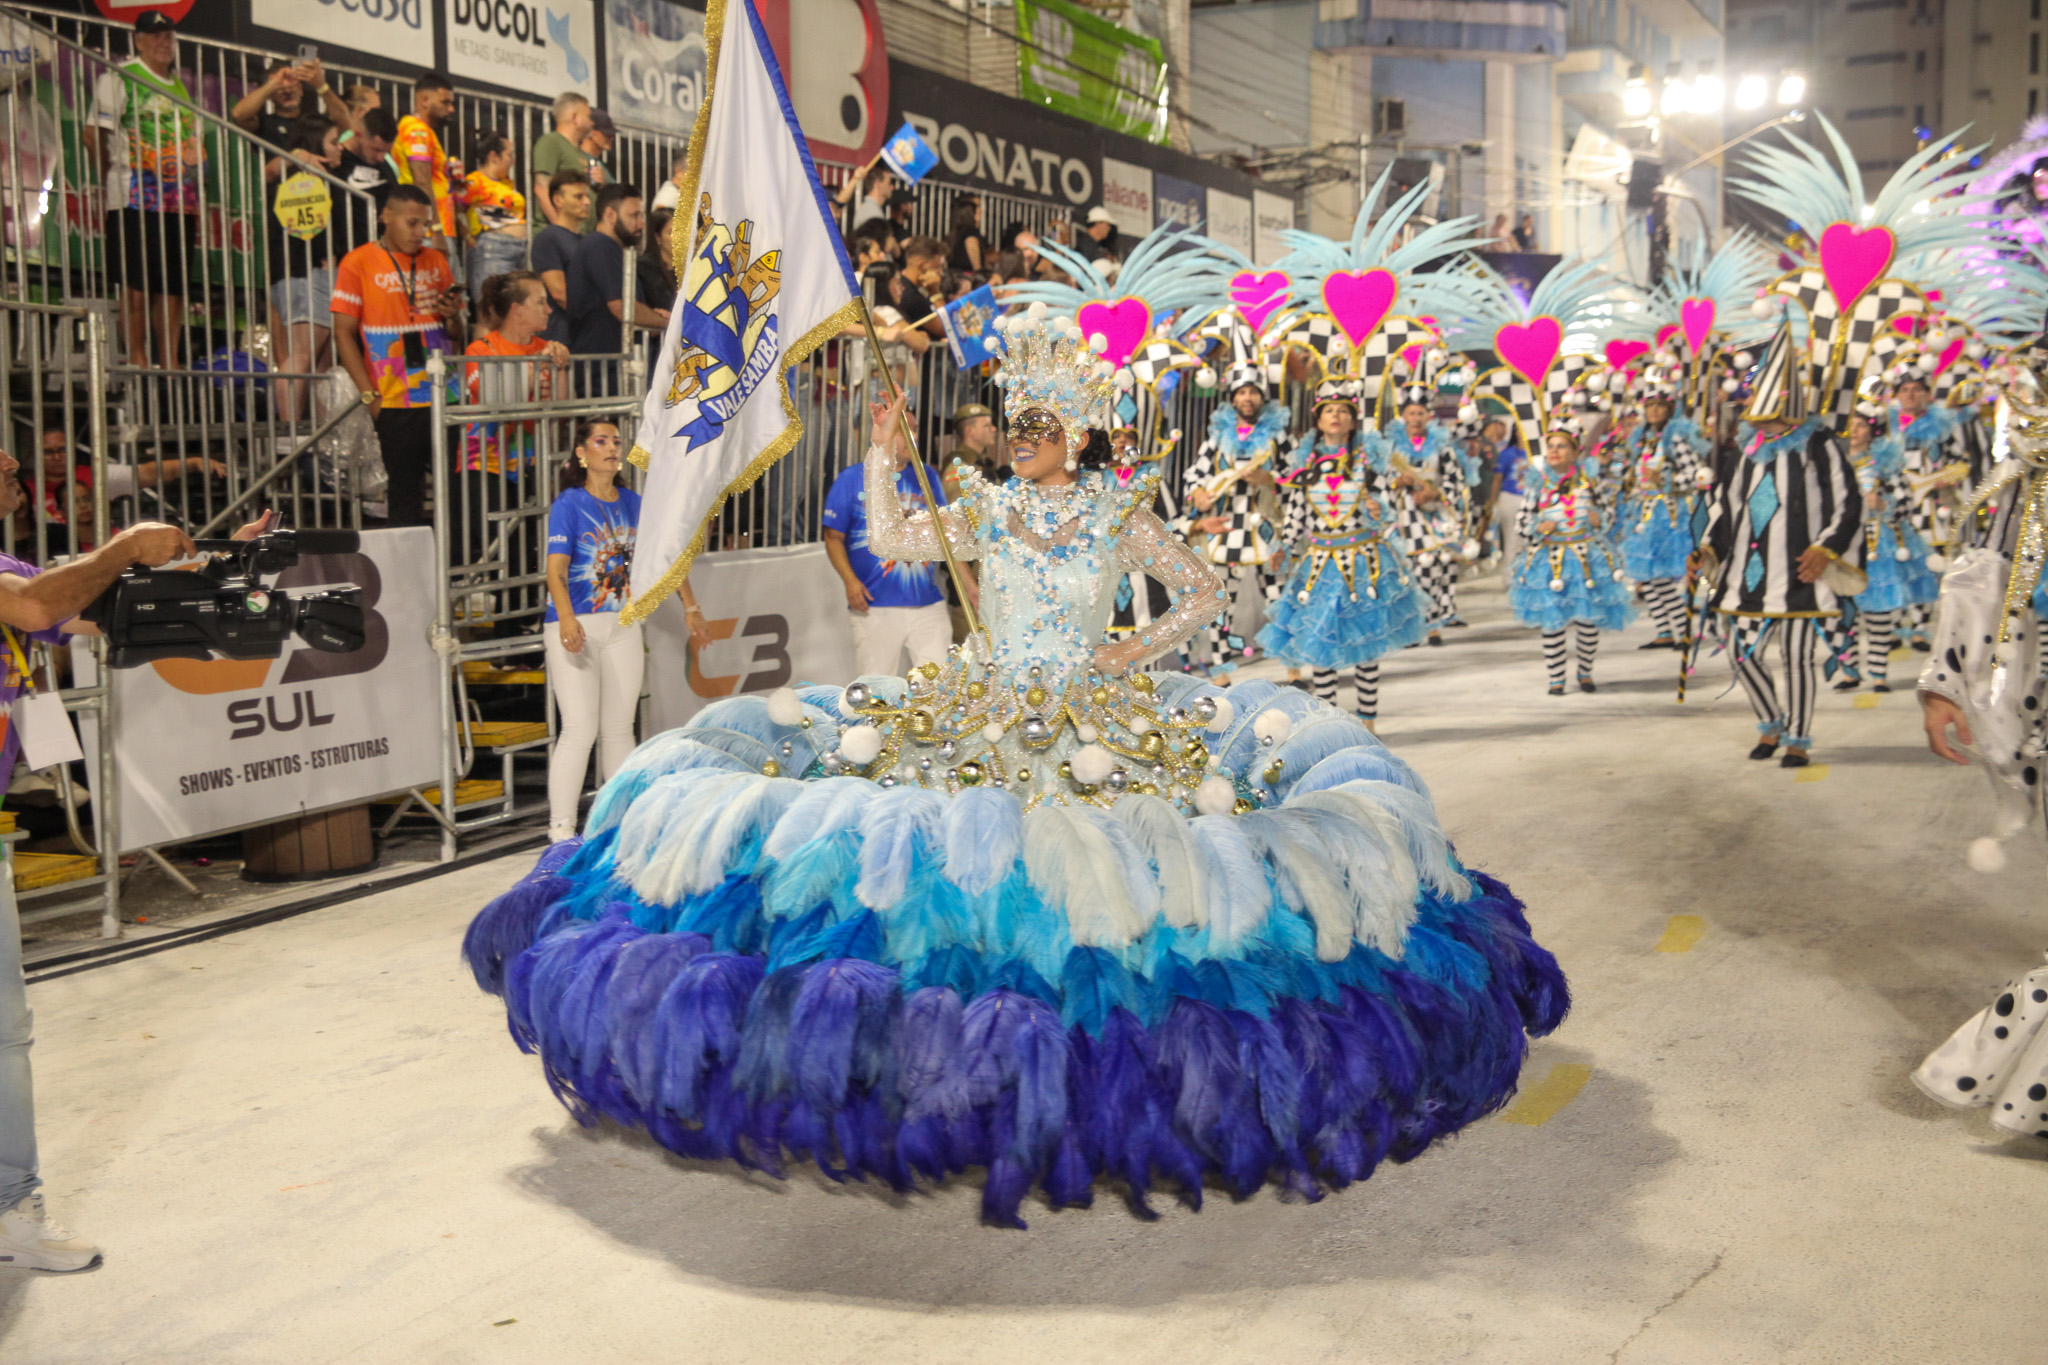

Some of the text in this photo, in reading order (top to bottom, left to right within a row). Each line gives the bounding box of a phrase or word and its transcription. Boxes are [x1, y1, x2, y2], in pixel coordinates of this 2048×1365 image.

[454, 0, 546, 48] DOCOL
[454, 36, 490, 62] METAIS
[622, 50, 704, 112] Coral
[902, 110, 1093, 205] BONATO
[297, 206, 315, 228] A5
[1103, 179, 1149, 213] eliane
[706, 325, 779, 420] VALE SAMBA
[322, 634, 345, 646] SONY
[685, 613, 792, 699] C3
[227, 690, 336, 740] SUL
[179, 767, 234, 796] SHOWS
[243, 753, 301, 783] EVENTOS
[311, 736, 390, 769] ESTRUTURAS
